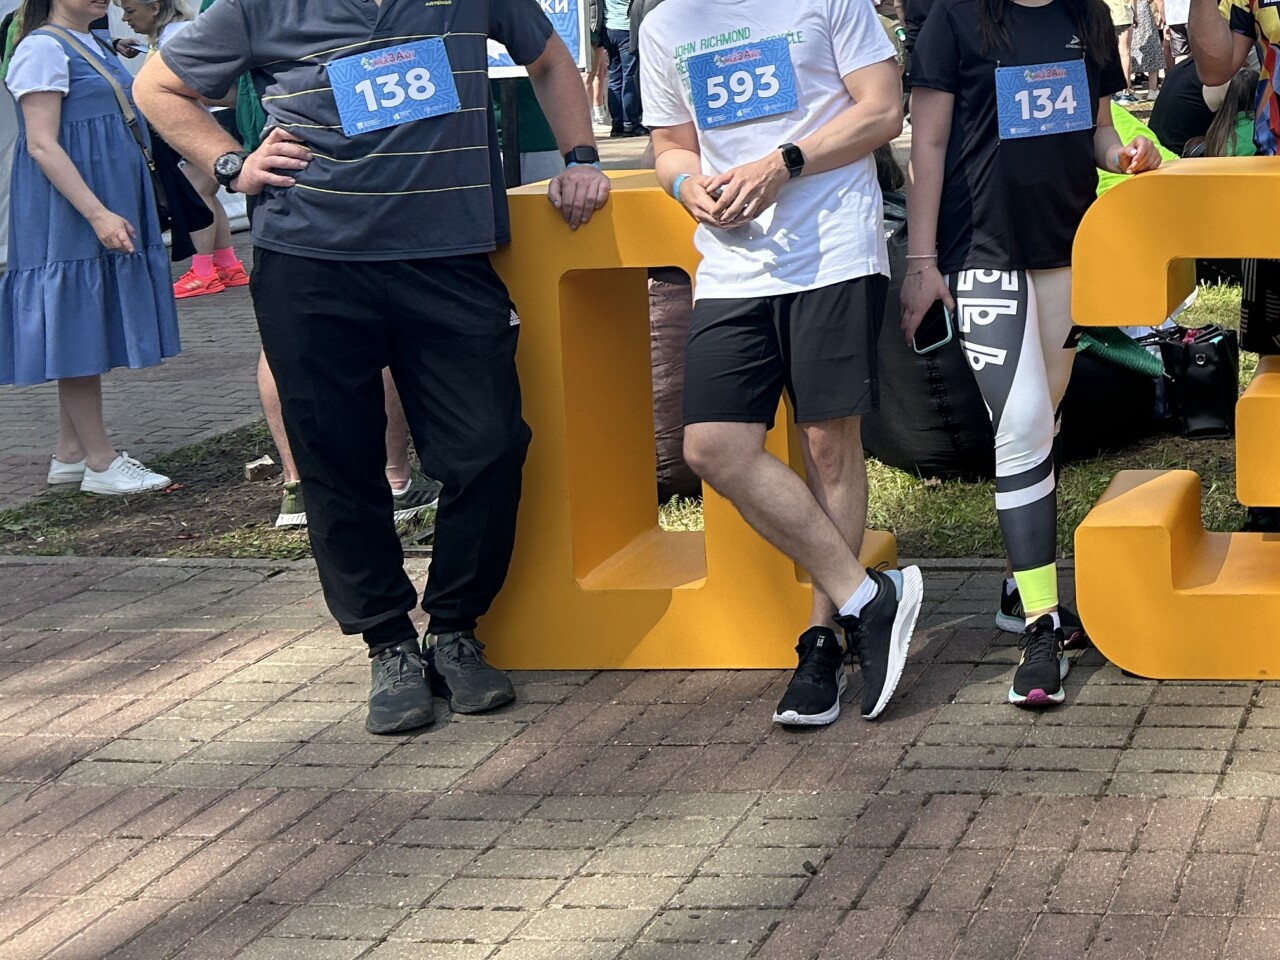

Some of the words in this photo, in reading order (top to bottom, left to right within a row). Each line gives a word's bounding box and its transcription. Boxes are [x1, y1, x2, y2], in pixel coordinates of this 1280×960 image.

[673, 41, 696, 59] JOHN
[700, 26, 751, 51] RICHMOND
[354, 67, 436, 112] 138
[706, 64, 780, 109] 593
[1014, 85, 1077, 120] 134
